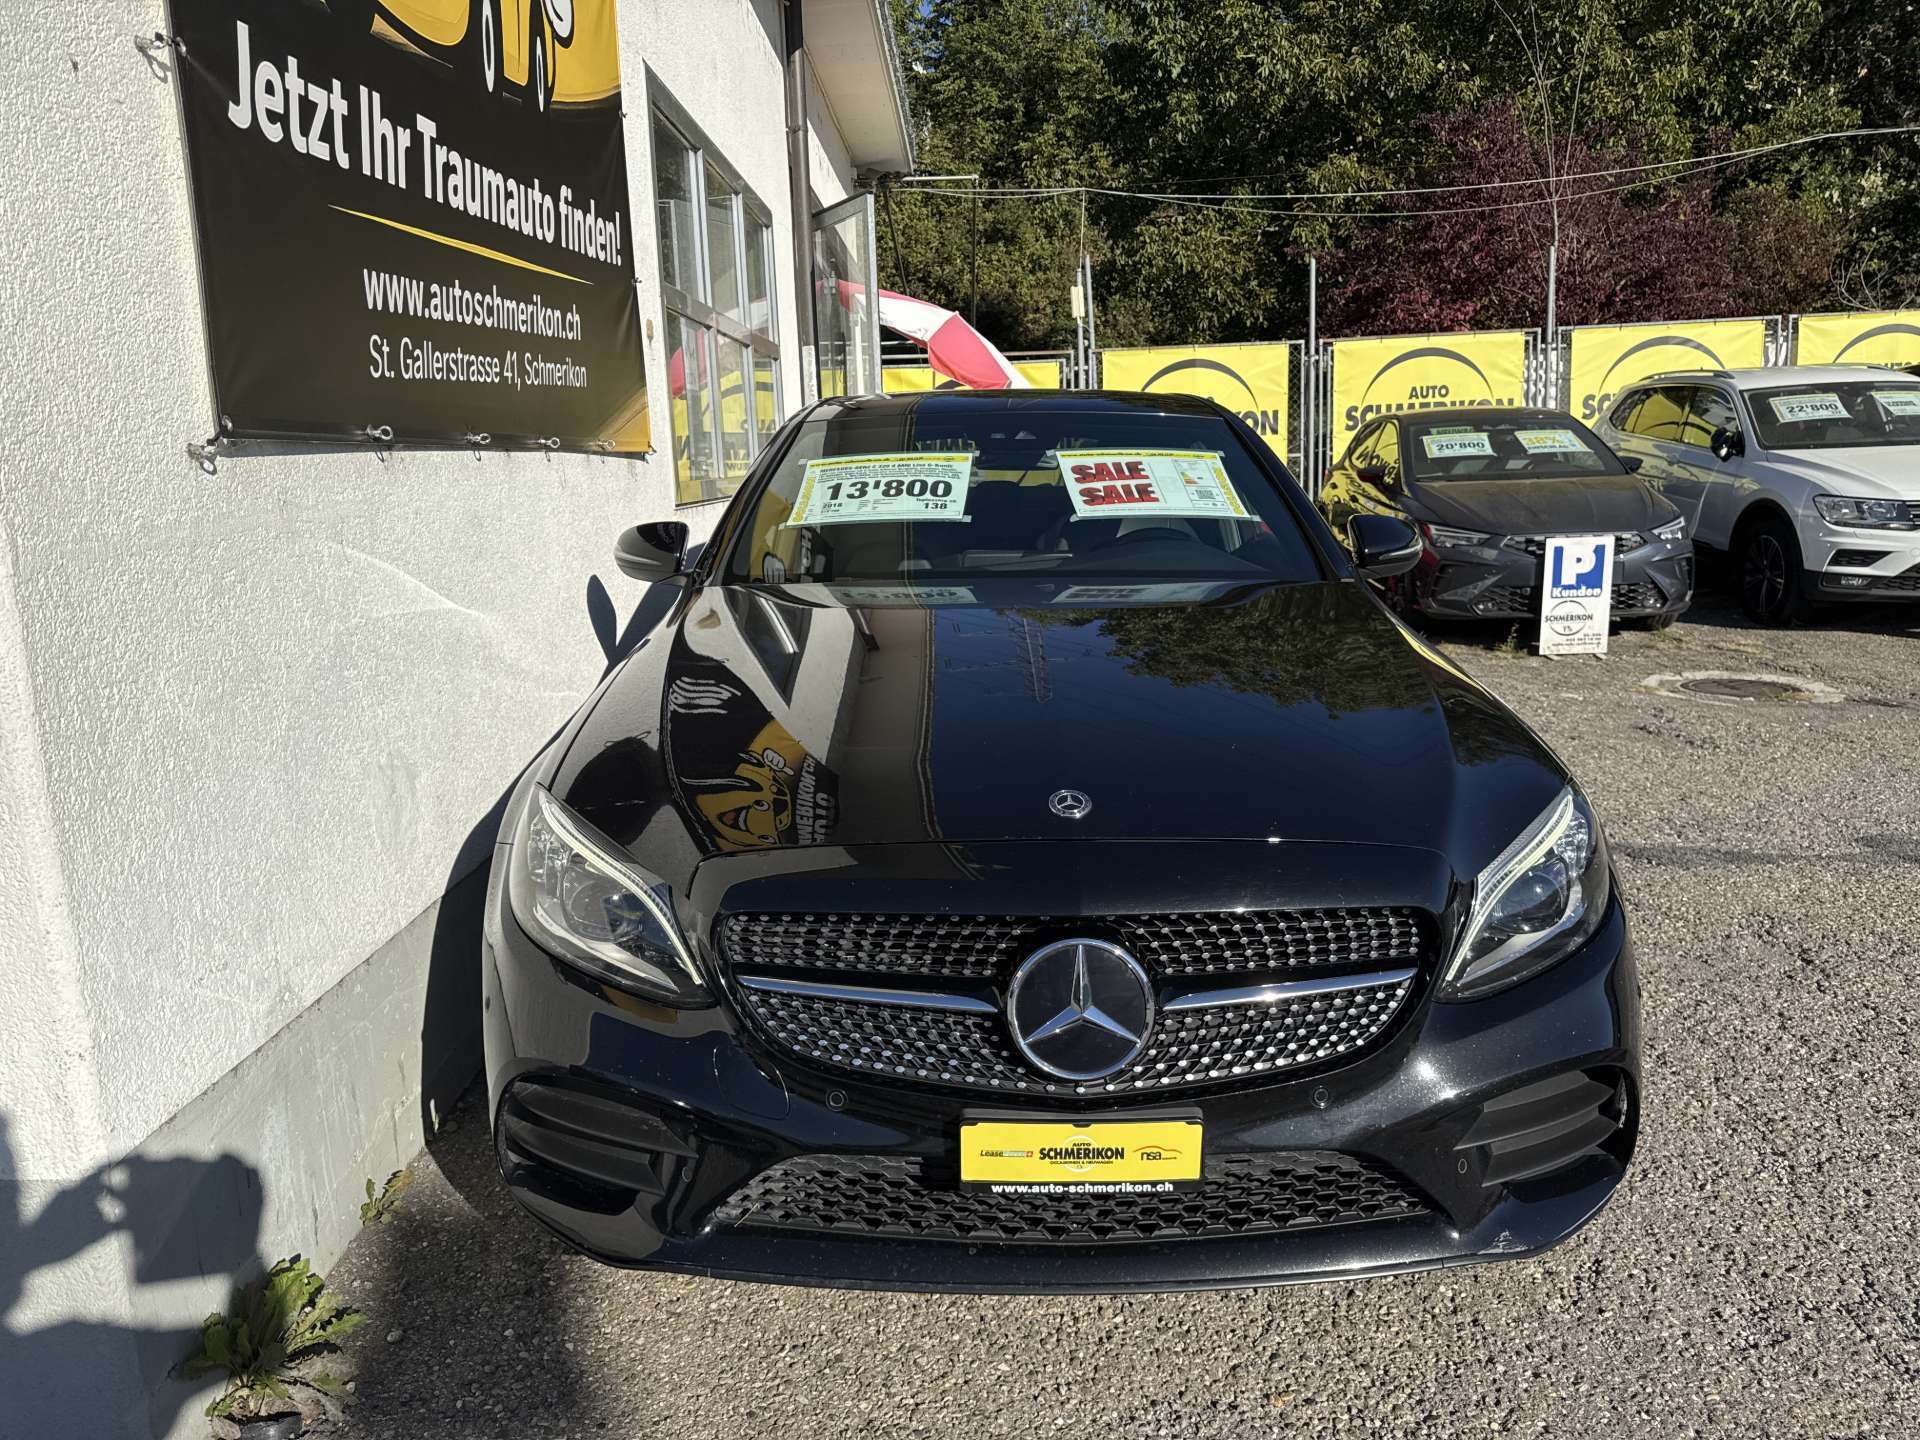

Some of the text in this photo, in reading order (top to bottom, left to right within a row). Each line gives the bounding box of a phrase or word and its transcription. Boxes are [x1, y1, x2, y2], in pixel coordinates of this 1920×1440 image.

[228, 20, 622, 266] Jetzt Ihr Traumauto finden!
[363, 268, 582, 341] www.autoschmerikon.ch
[369, 334, 587, 391] St. Gallerstrasse 41, Schmerikon
[1408, 385, 1450, 399] AUTO
[1786, 403, 1839, 413] 22'800
[1436, 441, 1485, 451] 20'800
[1070, 461, 1150, 484] SALE
[827, 479, 953, 501] 13'800
[1078, 483, 1160, 506] SALE
[924, 502, 948, 510] 138
[1561, 545, 1597, 586] P
[1552, 586, 1602, 598] Kunden
[1544, 613, 1594, 623] SCHMERIKON
[1039, 1147, 1125, 1160] SCHMERIKON
[1141, 1151, 1162, 1161] nsa
[991, 1182, 1174, 1193] www.auto-schmerikon.ch
